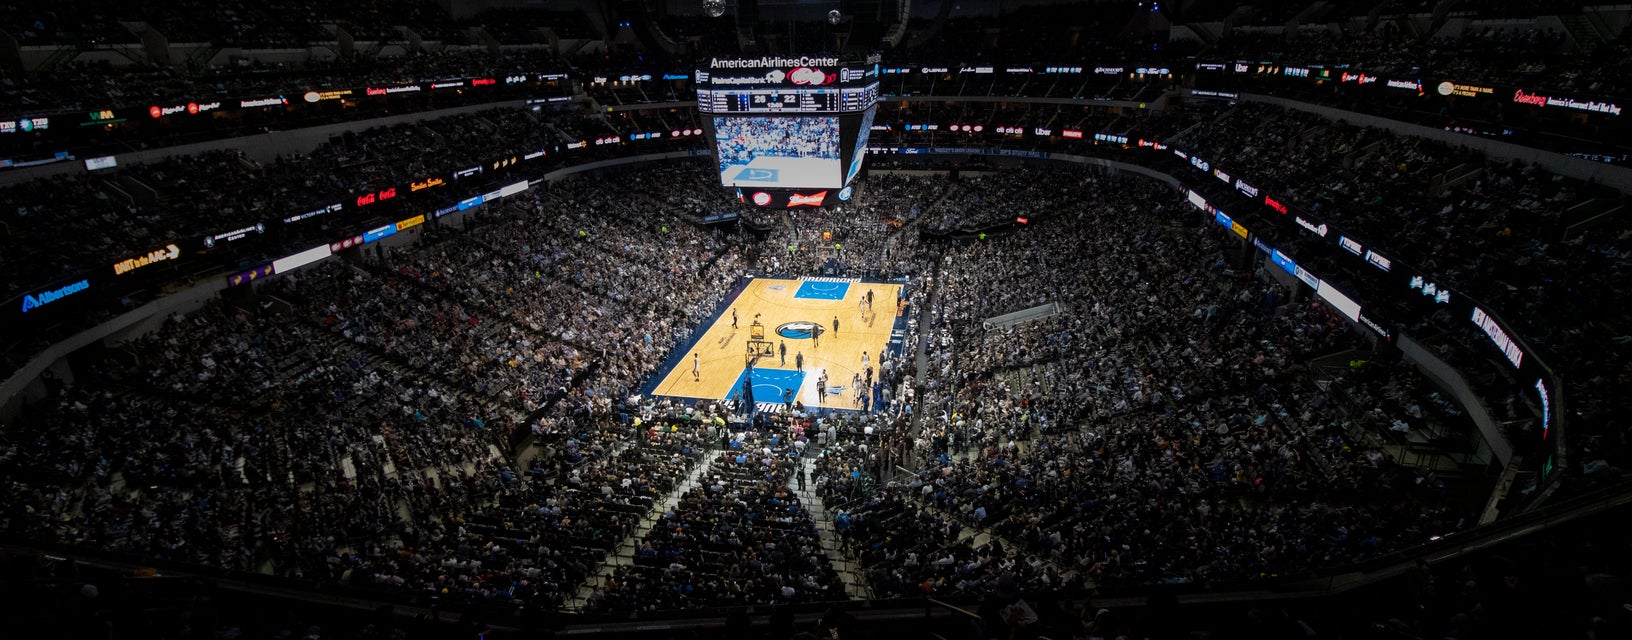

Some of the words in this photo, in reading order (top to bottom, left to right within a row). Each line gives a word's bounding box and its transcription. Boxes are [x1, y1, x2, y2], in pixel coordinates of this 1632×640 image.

[1235, 63, 1249, 73] Uber
[783, 95, 796, 103] 22
[1513, 88, 1546, 107] Eisenberg
[32, 118, 48, 126] TXU
[1035, 128, 1051, 136] Uber
[114, 258, 136, 276] DART
[147, 249, 167, 264] AAC
[37, 279, 90, 306] Albertsons
